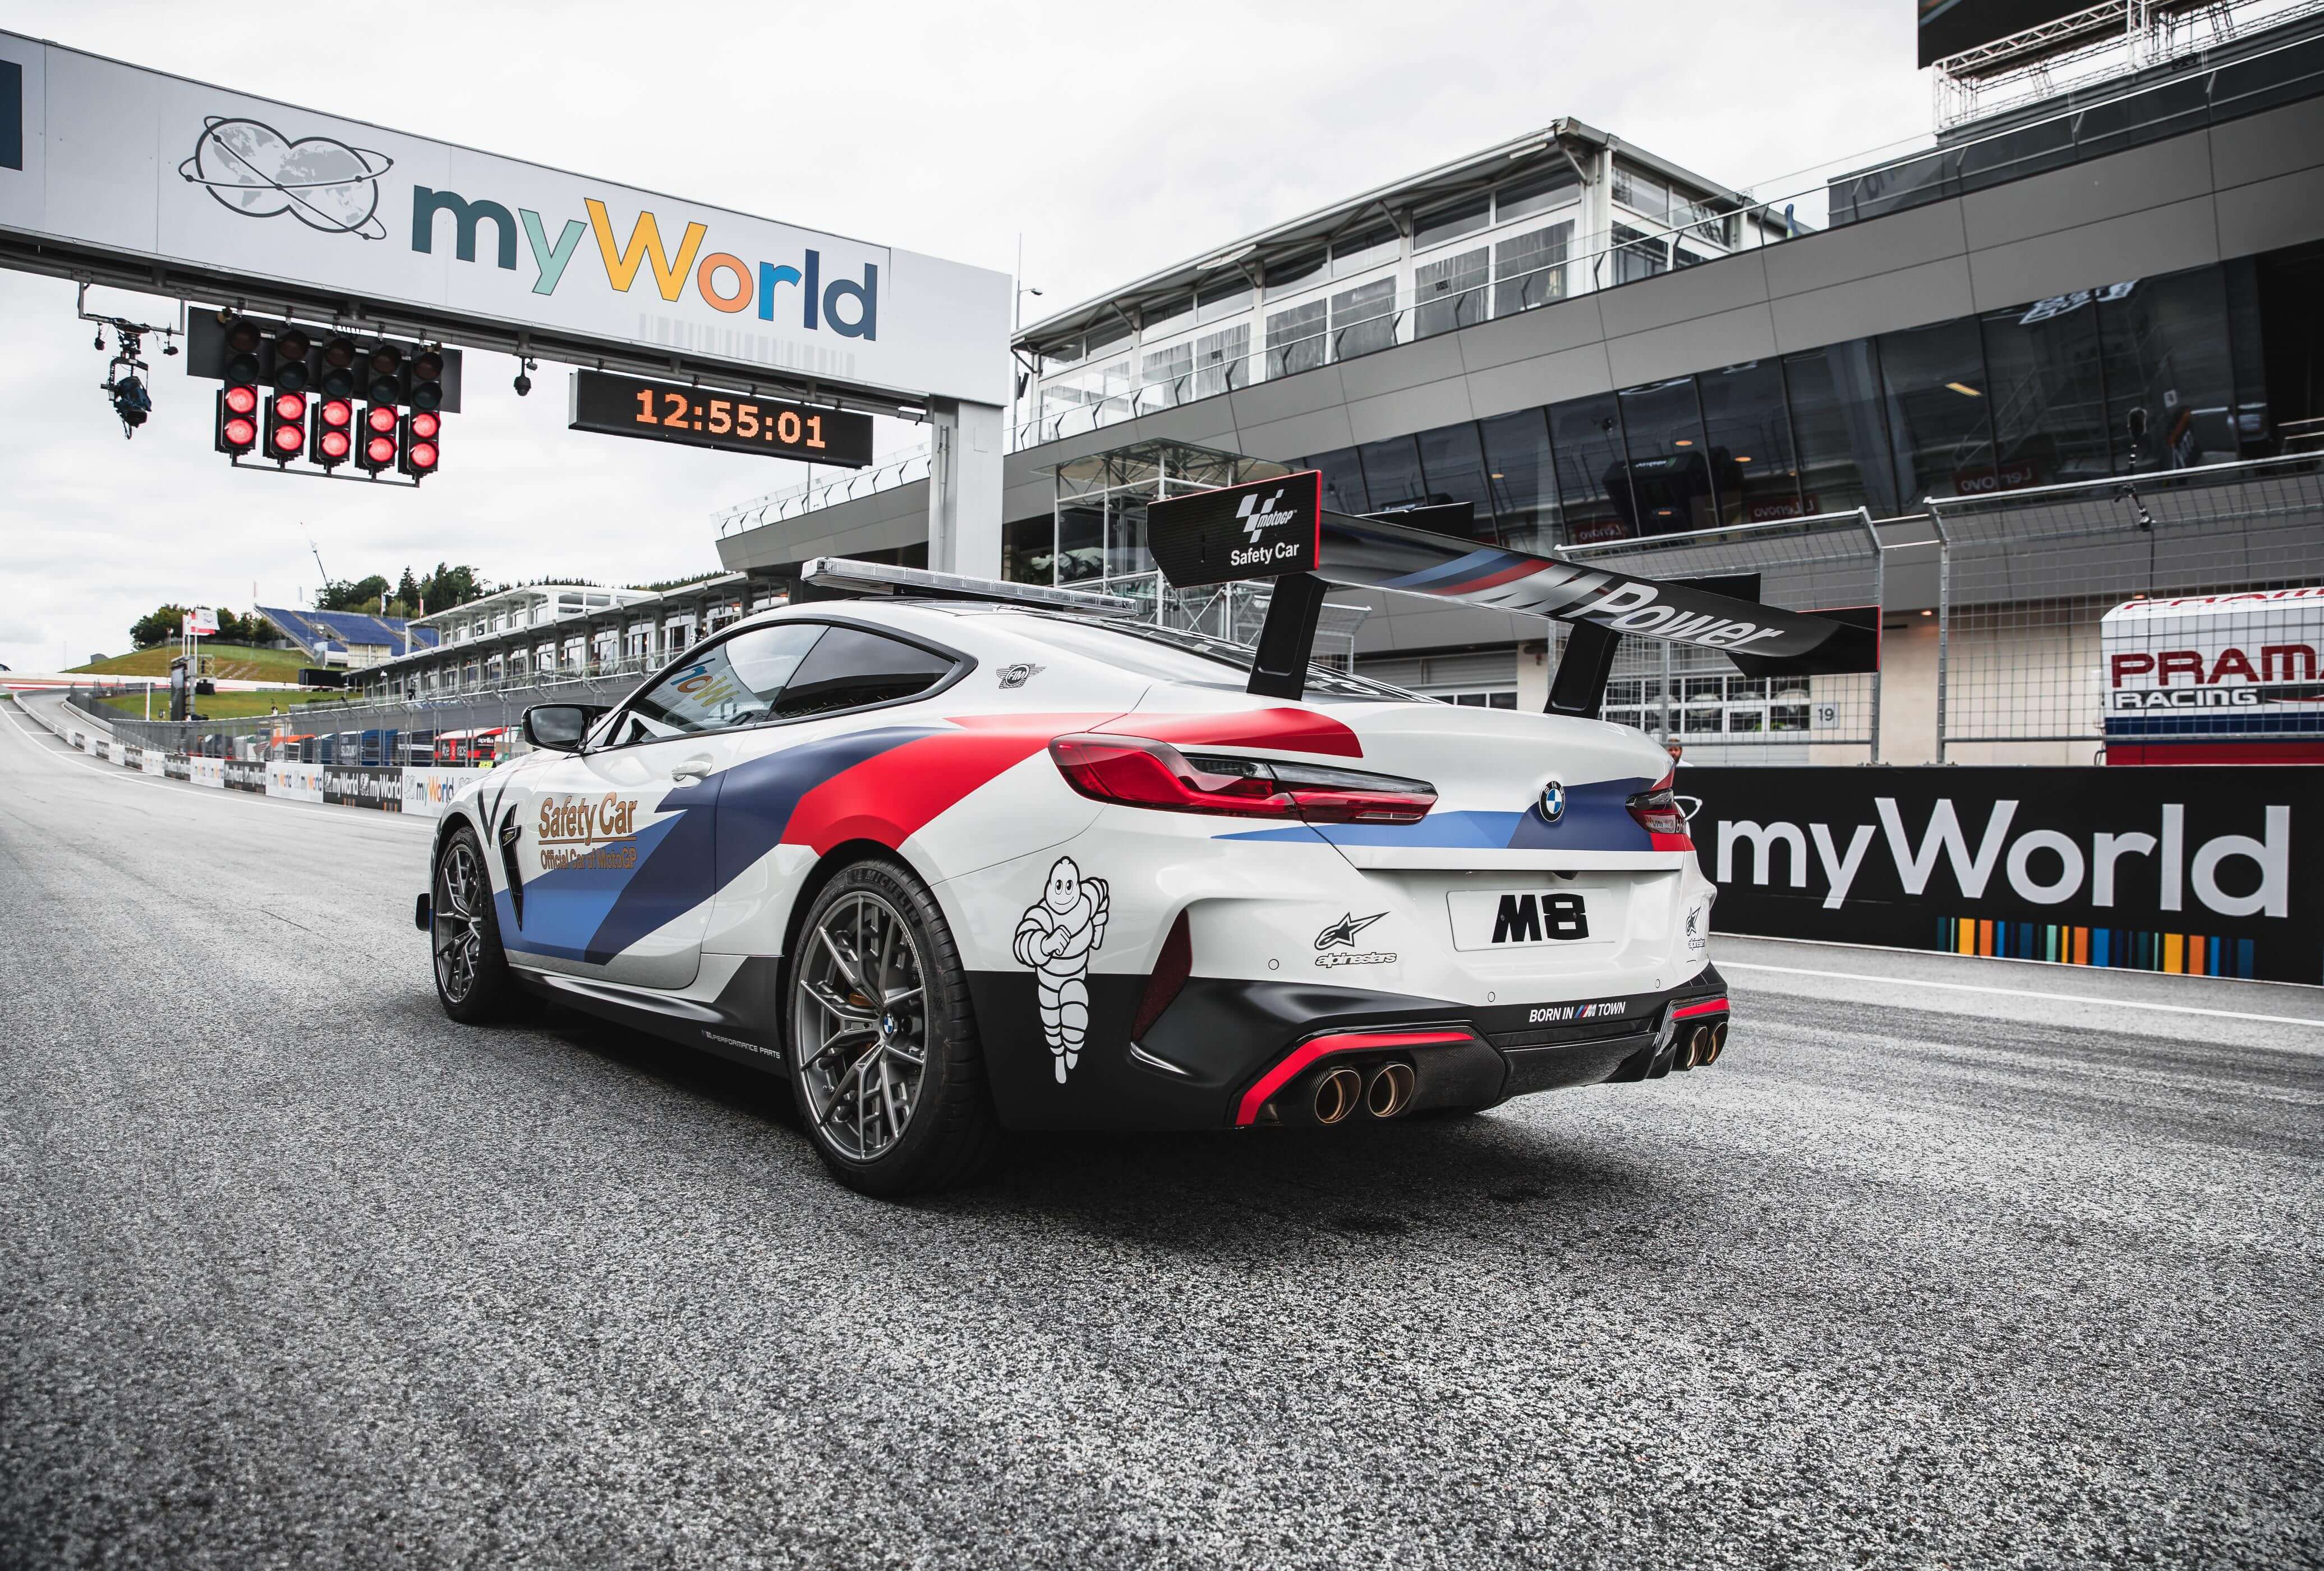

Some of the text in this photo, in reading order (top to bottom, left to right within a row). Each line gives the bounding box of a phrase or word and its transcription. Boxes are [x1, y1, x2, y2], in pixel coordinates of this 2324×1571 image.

[412, 184, 878, 341] myWorld
[636, 389, 826, 449] 12:55:01
[1230, 542, 1300, 566] Safety Car
[1557, 581, 1785, 647] Power
[1007, 670, 1026, 681] FIM
[2111, 644, 2324, 688] PRAM
[1817, 708, 1834, 722] 19
[332, 772, 402, 802] myWorld myWorld
[416, 776, 454, 806] myWorld
[538, 792, 638, 846] Safety Car
[540, 847, 638, 870] Official Car of MotoGP
[1716, 796, 2291, 919] myWorld
[1492, 893, 1589, 943] M8
[1315, 952, 1397, 968] alpinestars
[1529, 1007, 1562, 1022] BORN
[1562, 1007, 1574, 1020] IN
[1598, 1002, 1626, 1016] TOWN
[712, 1034, 758, 1053] PERFORMANCE
[760, 1047, 780, 1059] PARTS
